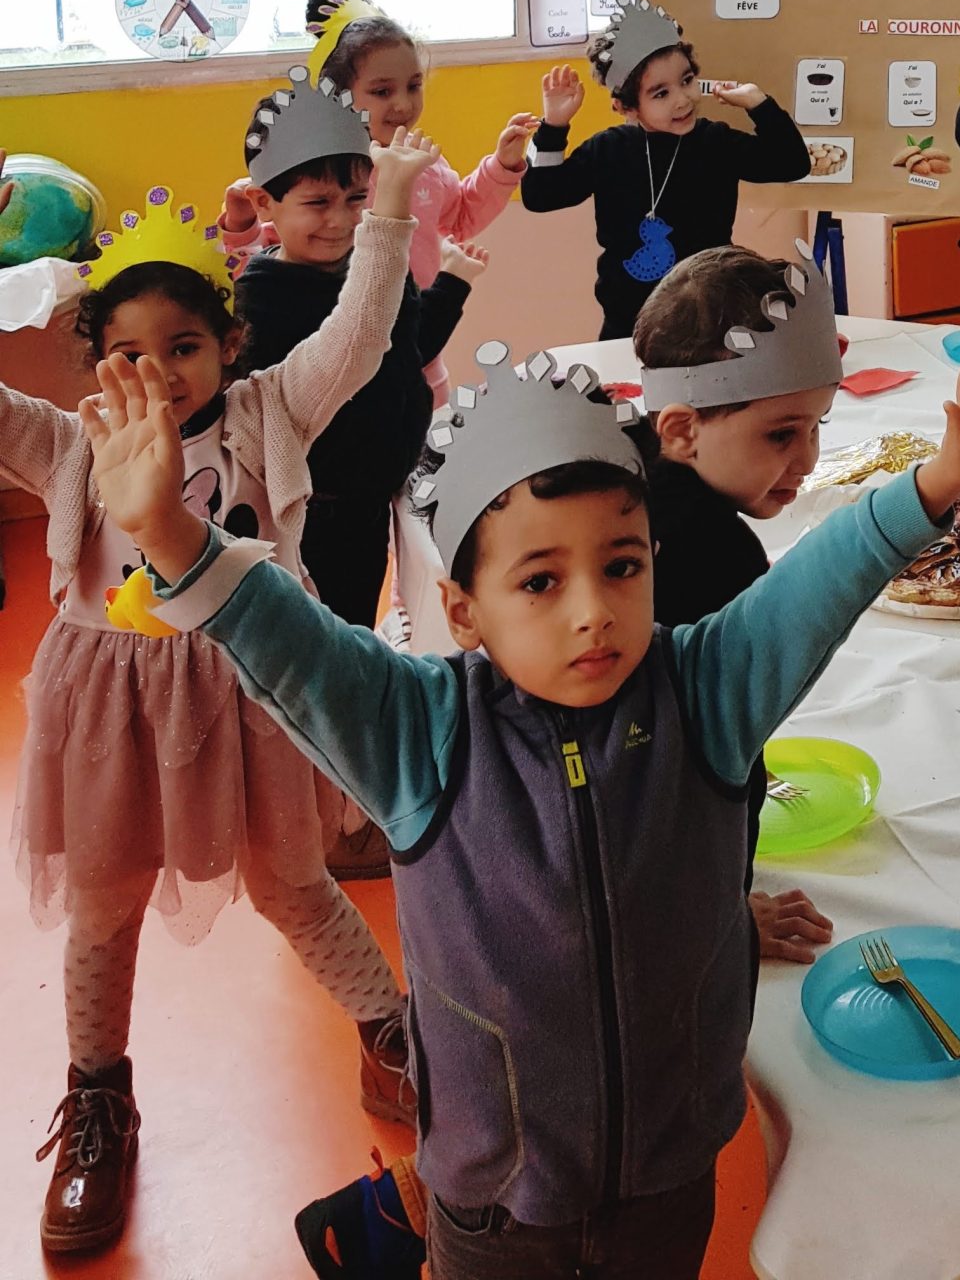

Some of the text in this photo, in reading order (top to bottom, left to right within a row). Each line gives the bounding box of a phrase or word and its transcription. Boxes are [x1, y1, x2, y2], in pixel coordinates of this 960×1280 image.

[737, 1, 758, 10] FÊVE
[860, 21, 877, 32] LA
[910, 177, 938, 188] AMANDE
